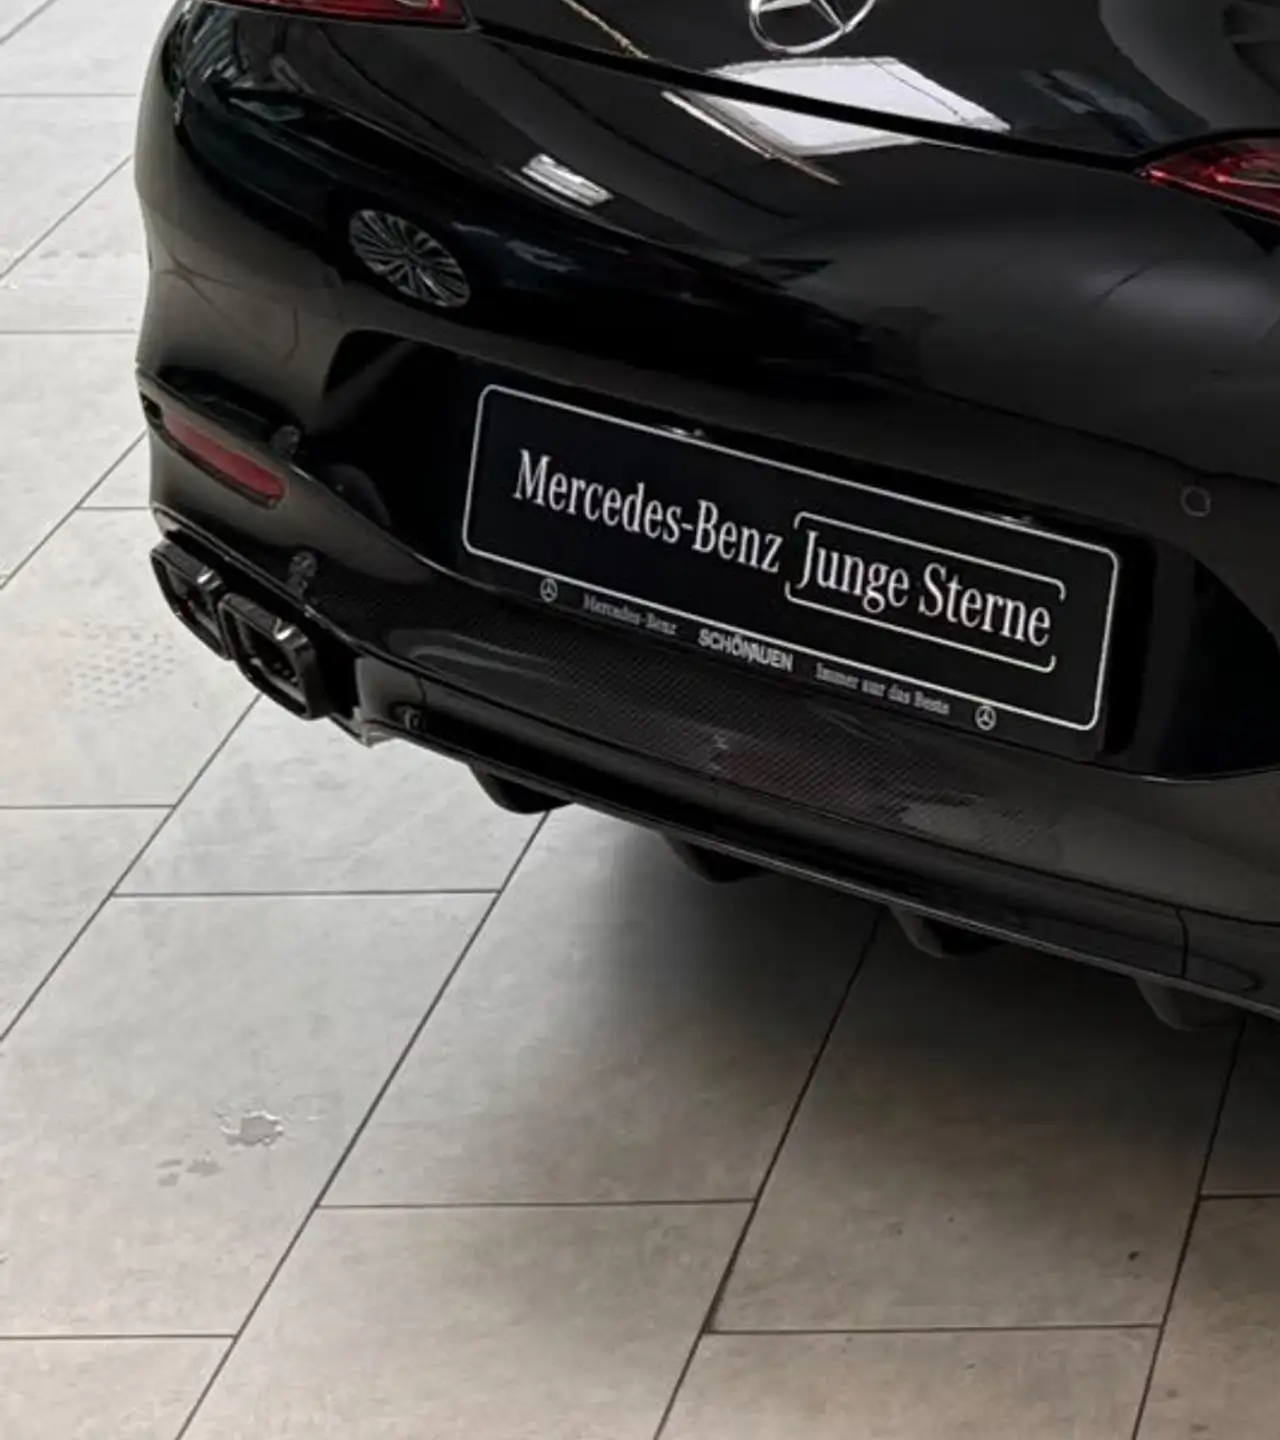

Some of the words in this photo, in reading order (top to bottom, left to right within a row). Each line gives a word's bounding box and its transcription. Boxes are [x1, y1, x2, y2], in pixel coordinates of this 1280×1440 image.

[513, 448, 784, 573] Mercedes-Benz
[799, 530, 910, 614] Junge
[917, 560, 1052, 648] Sterne
[582, 592, 679, 636] Mercedes-Benz
